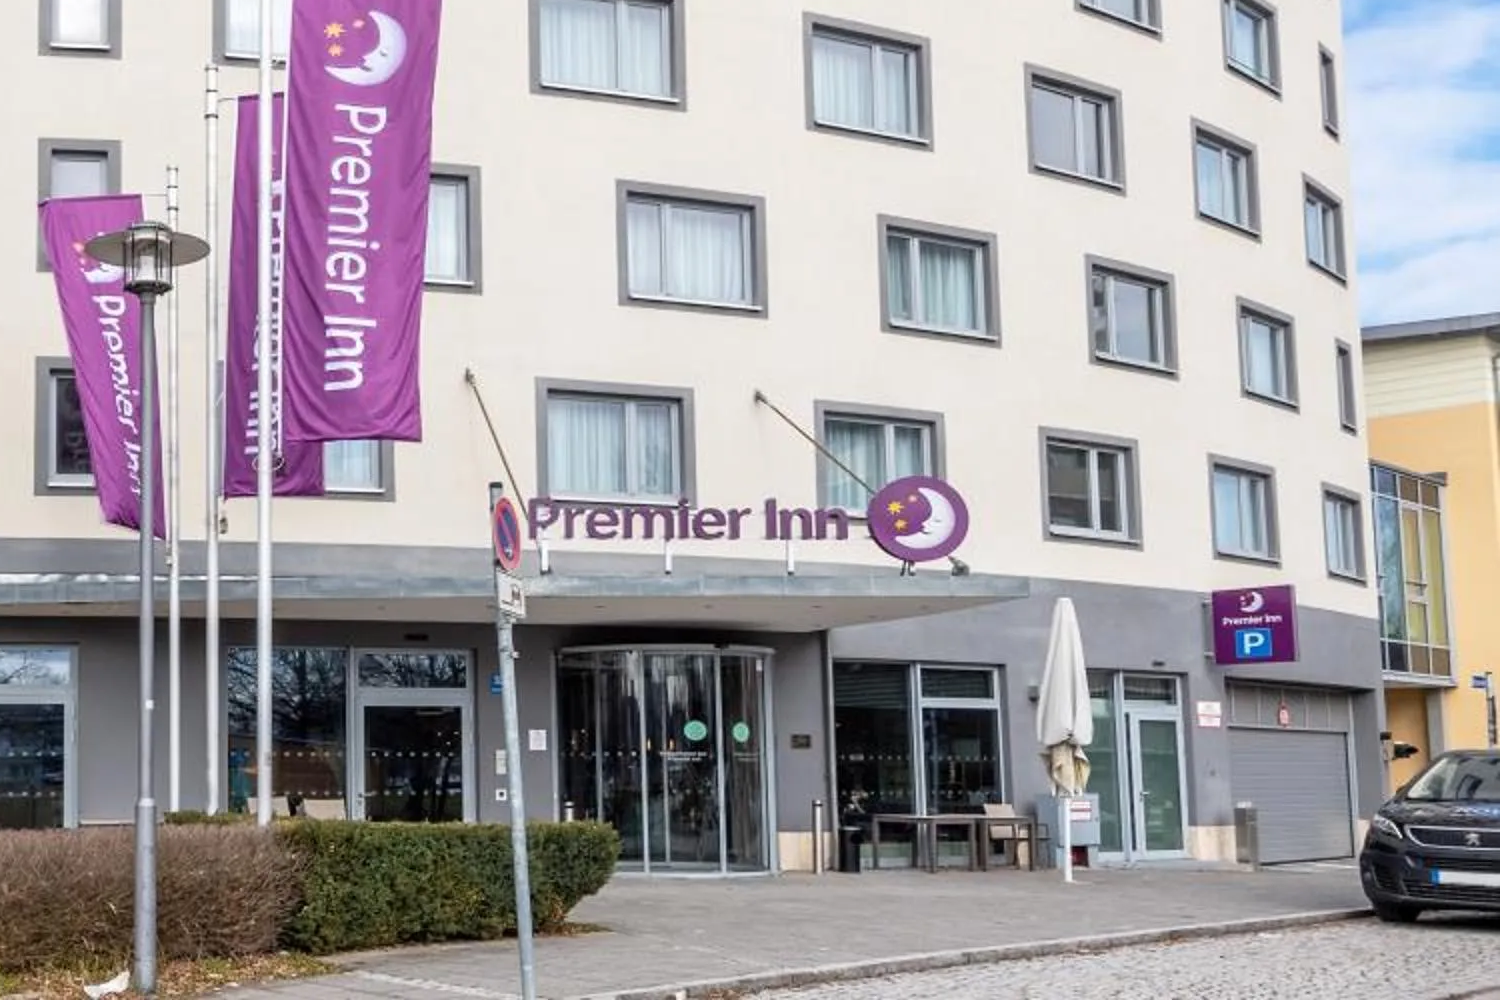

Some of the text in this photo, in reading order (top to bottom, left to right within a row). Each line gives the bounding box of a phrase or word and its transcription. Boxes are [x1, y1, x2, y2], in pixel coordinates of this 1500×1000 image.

[324, 103, 387, 391] Premier Inn
[91, 295, 139, 434] Premier
[527, 497, 849, 541] Premier Inn
[1243, 632, 1265, 656] P
